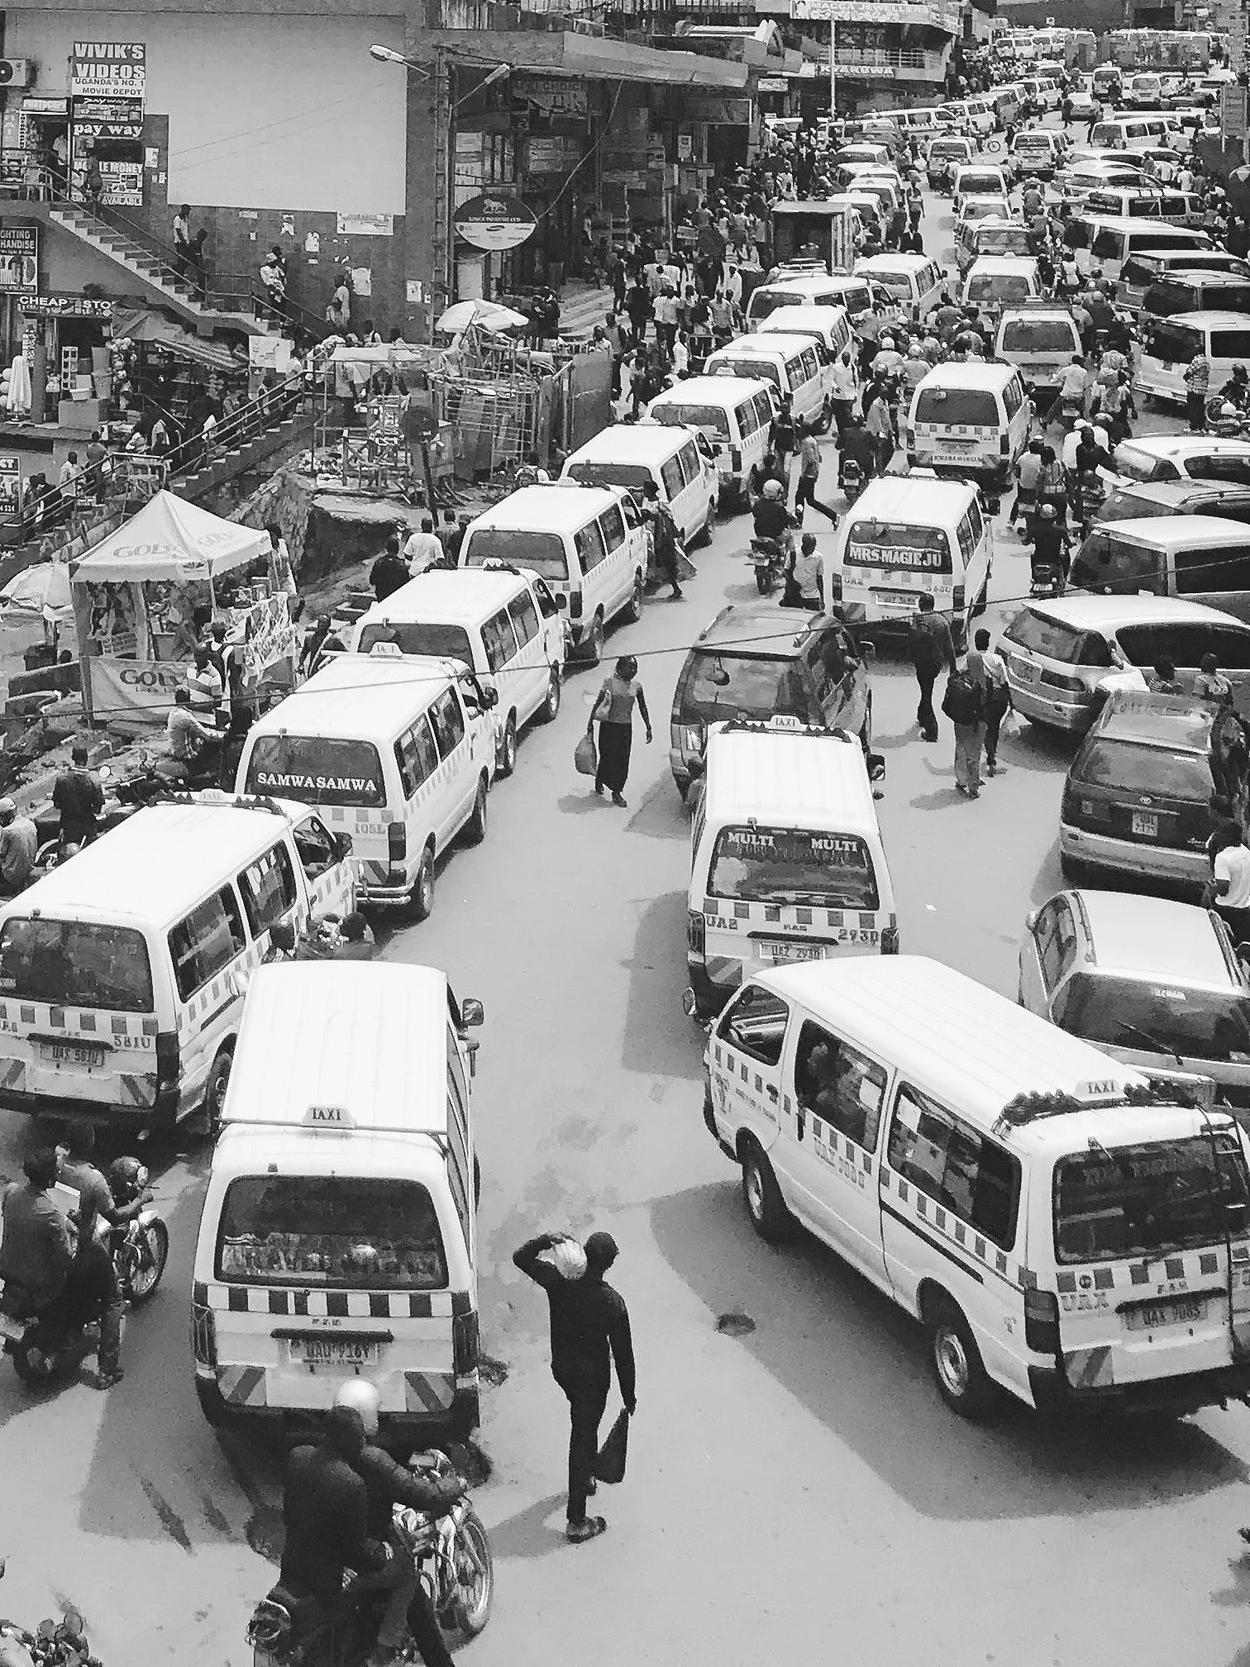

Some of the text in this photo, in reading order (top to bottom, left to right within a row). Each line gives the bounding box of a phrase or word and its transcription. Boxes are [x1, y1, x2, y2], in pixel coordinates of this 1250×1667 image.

[74, 43, 145, 60] VIVIK'S
[75, 63, 146, 79] VIDEOS
[74, 78, 119, 86] UGANDA'S
[82, 87, 143, 96] MOVIE DEPOT
[73, 124, 143, 137] pay way
[111, 162, 143, 174] MONEY
[19, 296, 115, 309] CHEAP STO
[850, 545, 880, 562] MRS
[376, 644, 396, 653] TAI
[728, 831, 858, 852] MULTI MULTI
[1085, 1080, 1116, 1094] TAXI
[310, 1107, 342, 1121] TAXI
